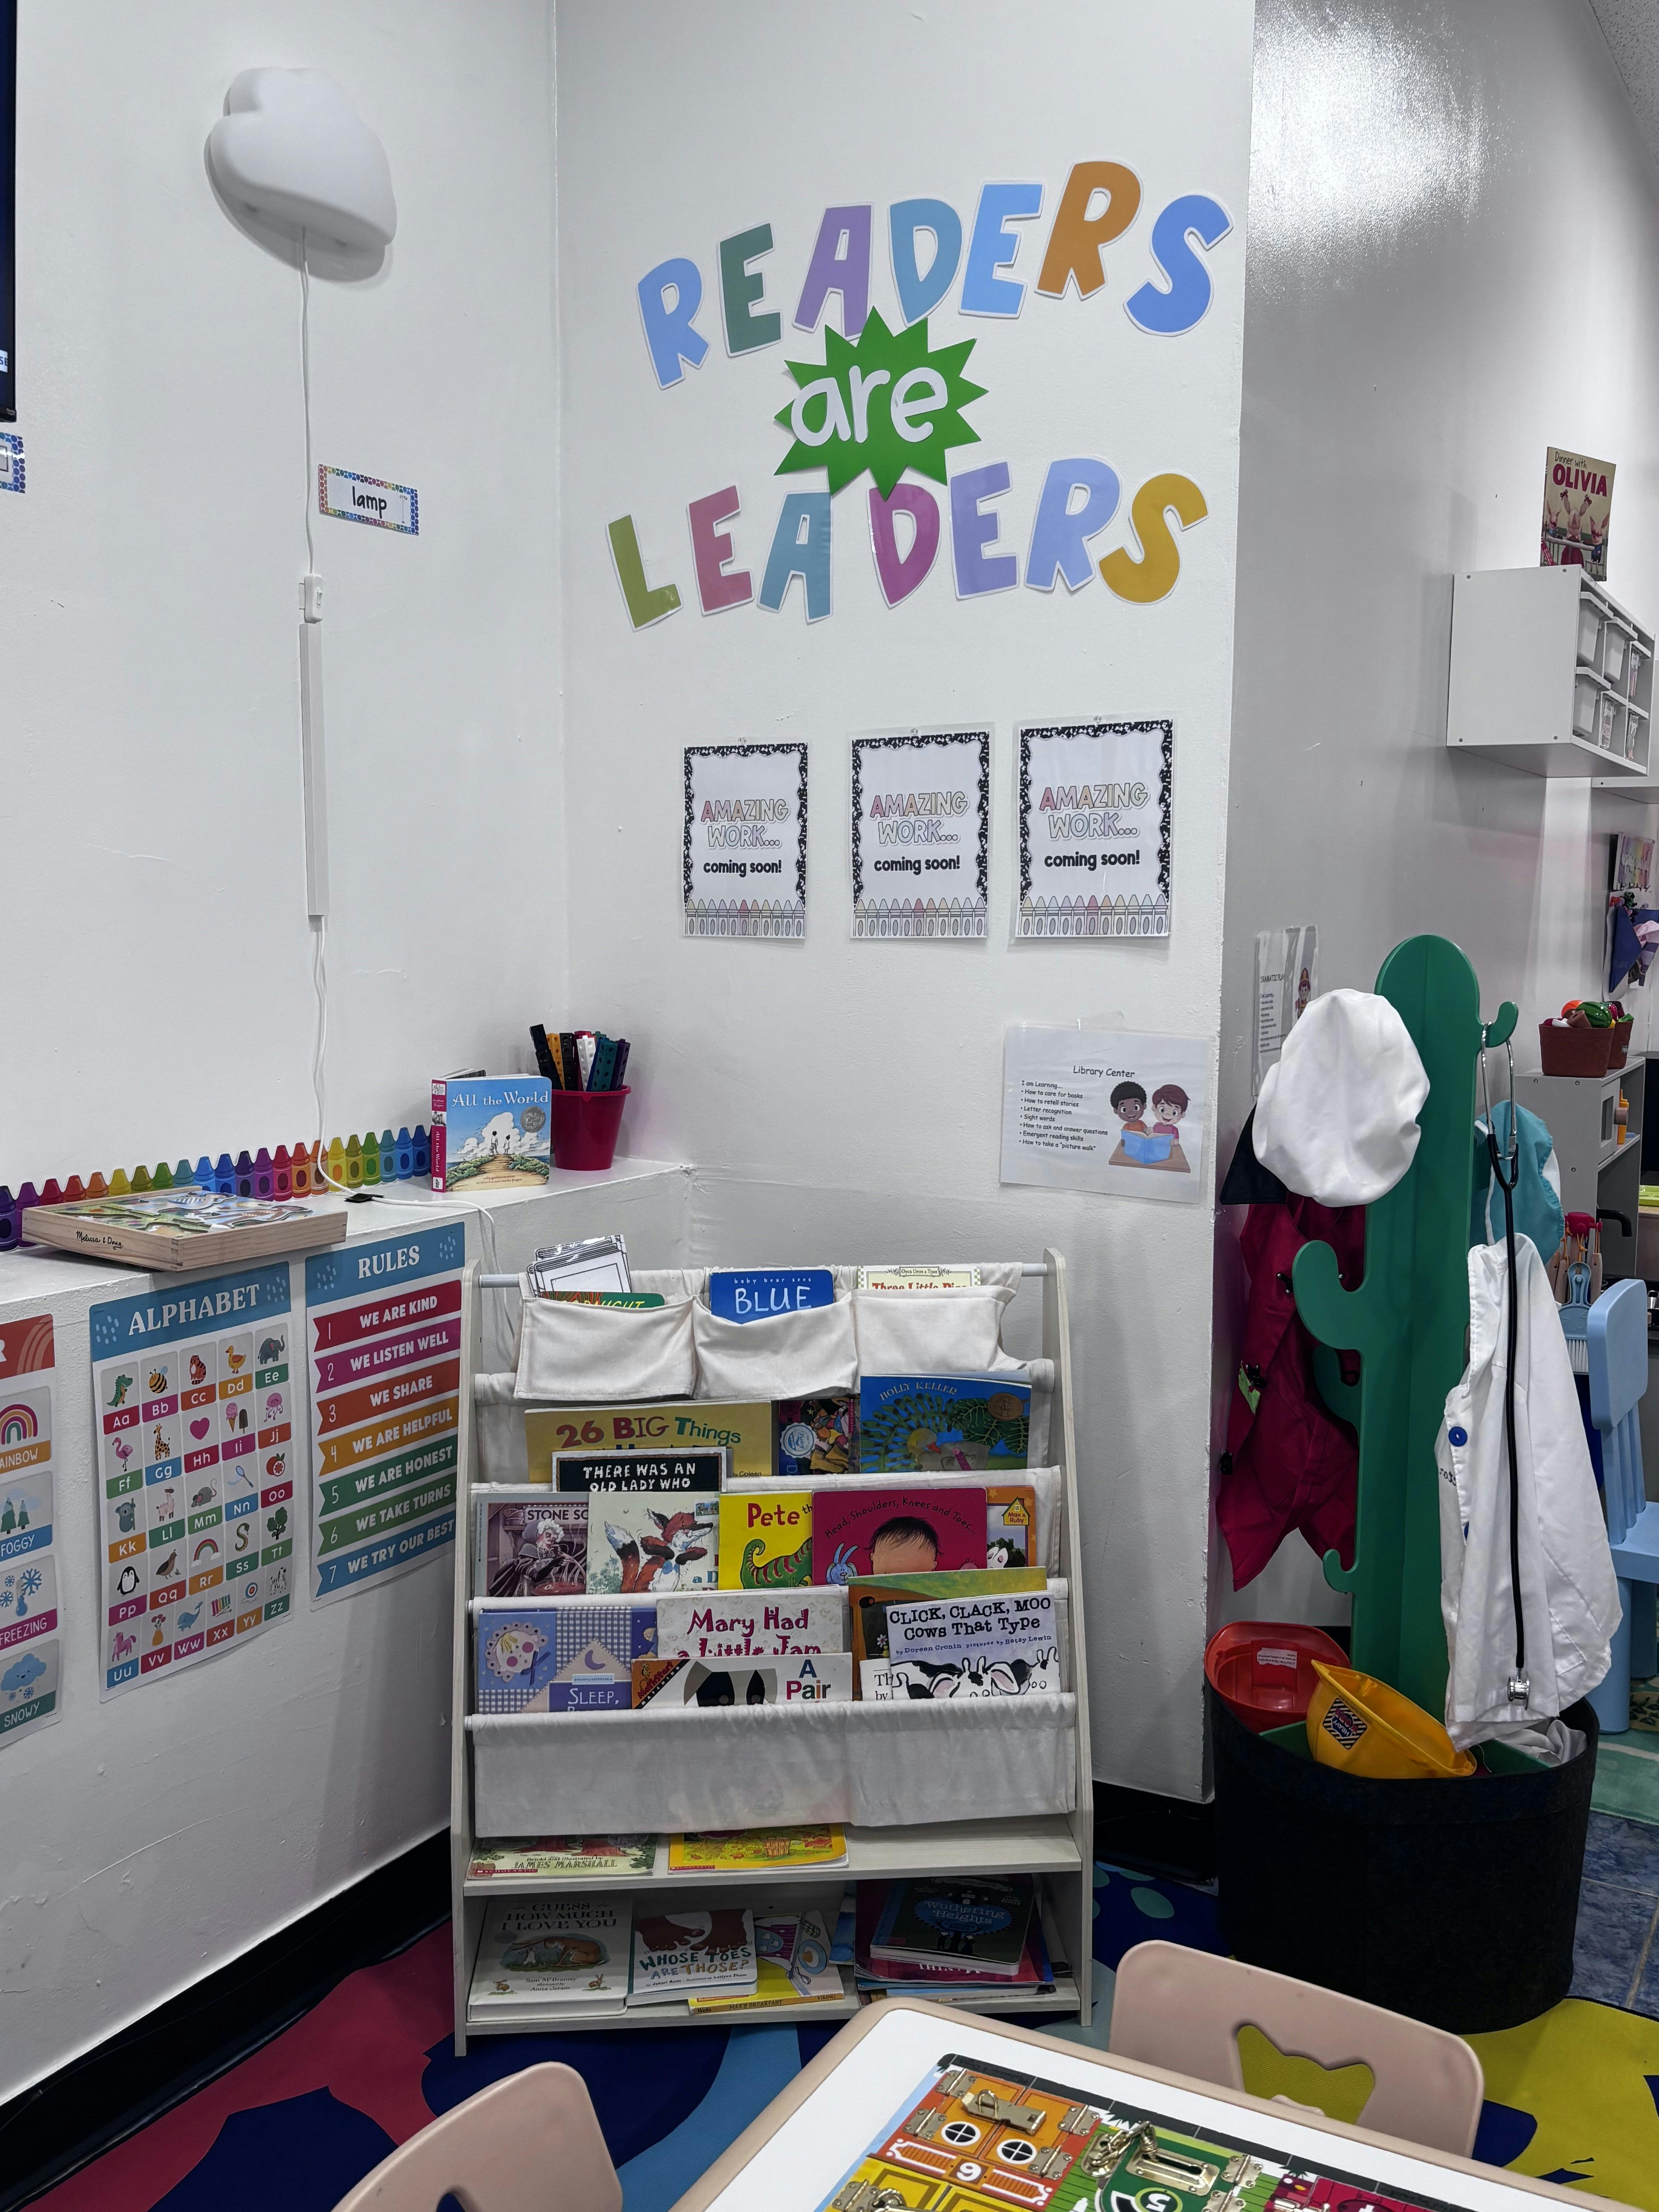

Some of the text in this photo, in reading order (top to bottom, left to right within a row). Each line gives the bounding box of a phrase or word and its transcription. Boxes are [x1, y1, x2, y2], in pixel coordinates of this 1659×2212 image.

[637, 161, 1231, 387] READERS
[791, 365, 948, 446] are
[1555, 451, 1587, 469] Dinner with
[1553, 463, 1607, 497] OLIVIA
[352, 486, 387, 519] lamp
[609, 458, 1209, 629] LEADERS
[870, 792, 967, 818] AMAZING
[1039, 782, 1148, 811] AMAZING
[701, 799, 788, 822] AMAZING
[708, 825, 780, 847] WORK...
[878, 820, 958, 844] WORK...
[1048, 812, 1137, 838] WORK...
[704, 859, 781, 878] coming soon!
[874, 855, 960, 875] coming soon!
[1044, 850, 1140, 871] coming soon!
[1073, 1065, 1135, 1078] Library Center
[451, 1093, 479, 1107] All
[483, 1096, 502, 1105] the
[503, 1090, 549, 1104] World
[1023, 1130, 1048, 1139] Emergent
[359, 1245, 419, 1279] RULES
[128, 1283, 260, 1336] ALPHABET
[360, 1311, 379, 1328] WE
[382, 1305, 406, 1323] ARE
[409, 1295, 438, 1314] KIND
[735, 1286, 812, 1314] BLUE
[328, 1331, 449, 1381] 2 WE LISTEN WELL
[113, 1371, 279, 1429] Aa Bb Cc Dd Ee
[329, 1375, 433, 1423] 3 WE SHARE
[879, 1381, 958, 1401] HOLLY KELLER
[331, 1408, 452, 1463] 4 WE ARE HELPFUL
[556, 1416, 742, 1448] 26 BIG Things
[118, 1429, 280, 1492] Ff Gg Hh Ii Jj
[583, 1462, 696, 1479] THERE WAS AN
[332, 1445, 452, 1504] 5 WE ARE HONEST
[590, 1478, 690, 1492] OLD LADY WHO
[119, 1489, 285, 1556] Kk Ll Mm Nn Oo
[330, 1484, 451, 1544] 6 WE TAKE TURNS
[527, 1510, 569, 1521] STONE
[747, 1502, 800, 1528] Pete
[824, 1518, 851, 1540] Head,
[850, 1499, 899, 1520] Shoulders,
[902, 1496, 930, 1508] Knees
[933, 1504, 950, 1516] and
[0, 1534, 35, 1557] FOGGY
[329, 1519, 454, 1583] 7 WE TRY OUR BEST
[119, 1546, 283, 1620] Pp Qq Rr Ss Tt
[687, 1606, 809, 1638] Mary Had
[890, 1597, 1051, 1625] CLICK, CLACK, MOO
[0, 1617, 47, 1645] FREEZING
[904, 1617, 1040, 1641] Cows That Type
[799, 1659, 817, 1678] A
[786, 1680, 831, 1700] Pair
[4, 1701, 40, 1728] SNOWY
[1333, 1719, 1350, 1736] HEAVY
[1334, 1707, 1358, 1735] WORK
[512, 1859, 617, 1869] JAMES MARSHALL
[507, 1910, 613, 1920] HOW MUCH
[532, 1903, 590, 1911] GUESS
[925, 1901, 1005, 1919] Wuthering
[933, 1910, 992, 1924] Heights
[502, 1918, 617, 1930] I LOVE YOU
[639, 1948, 752, 1971] WHOSE TOES
[651, 1960, 749, 1980] ARE THOSE?
[749, 2000, 783, 2008] BREAKFAST
